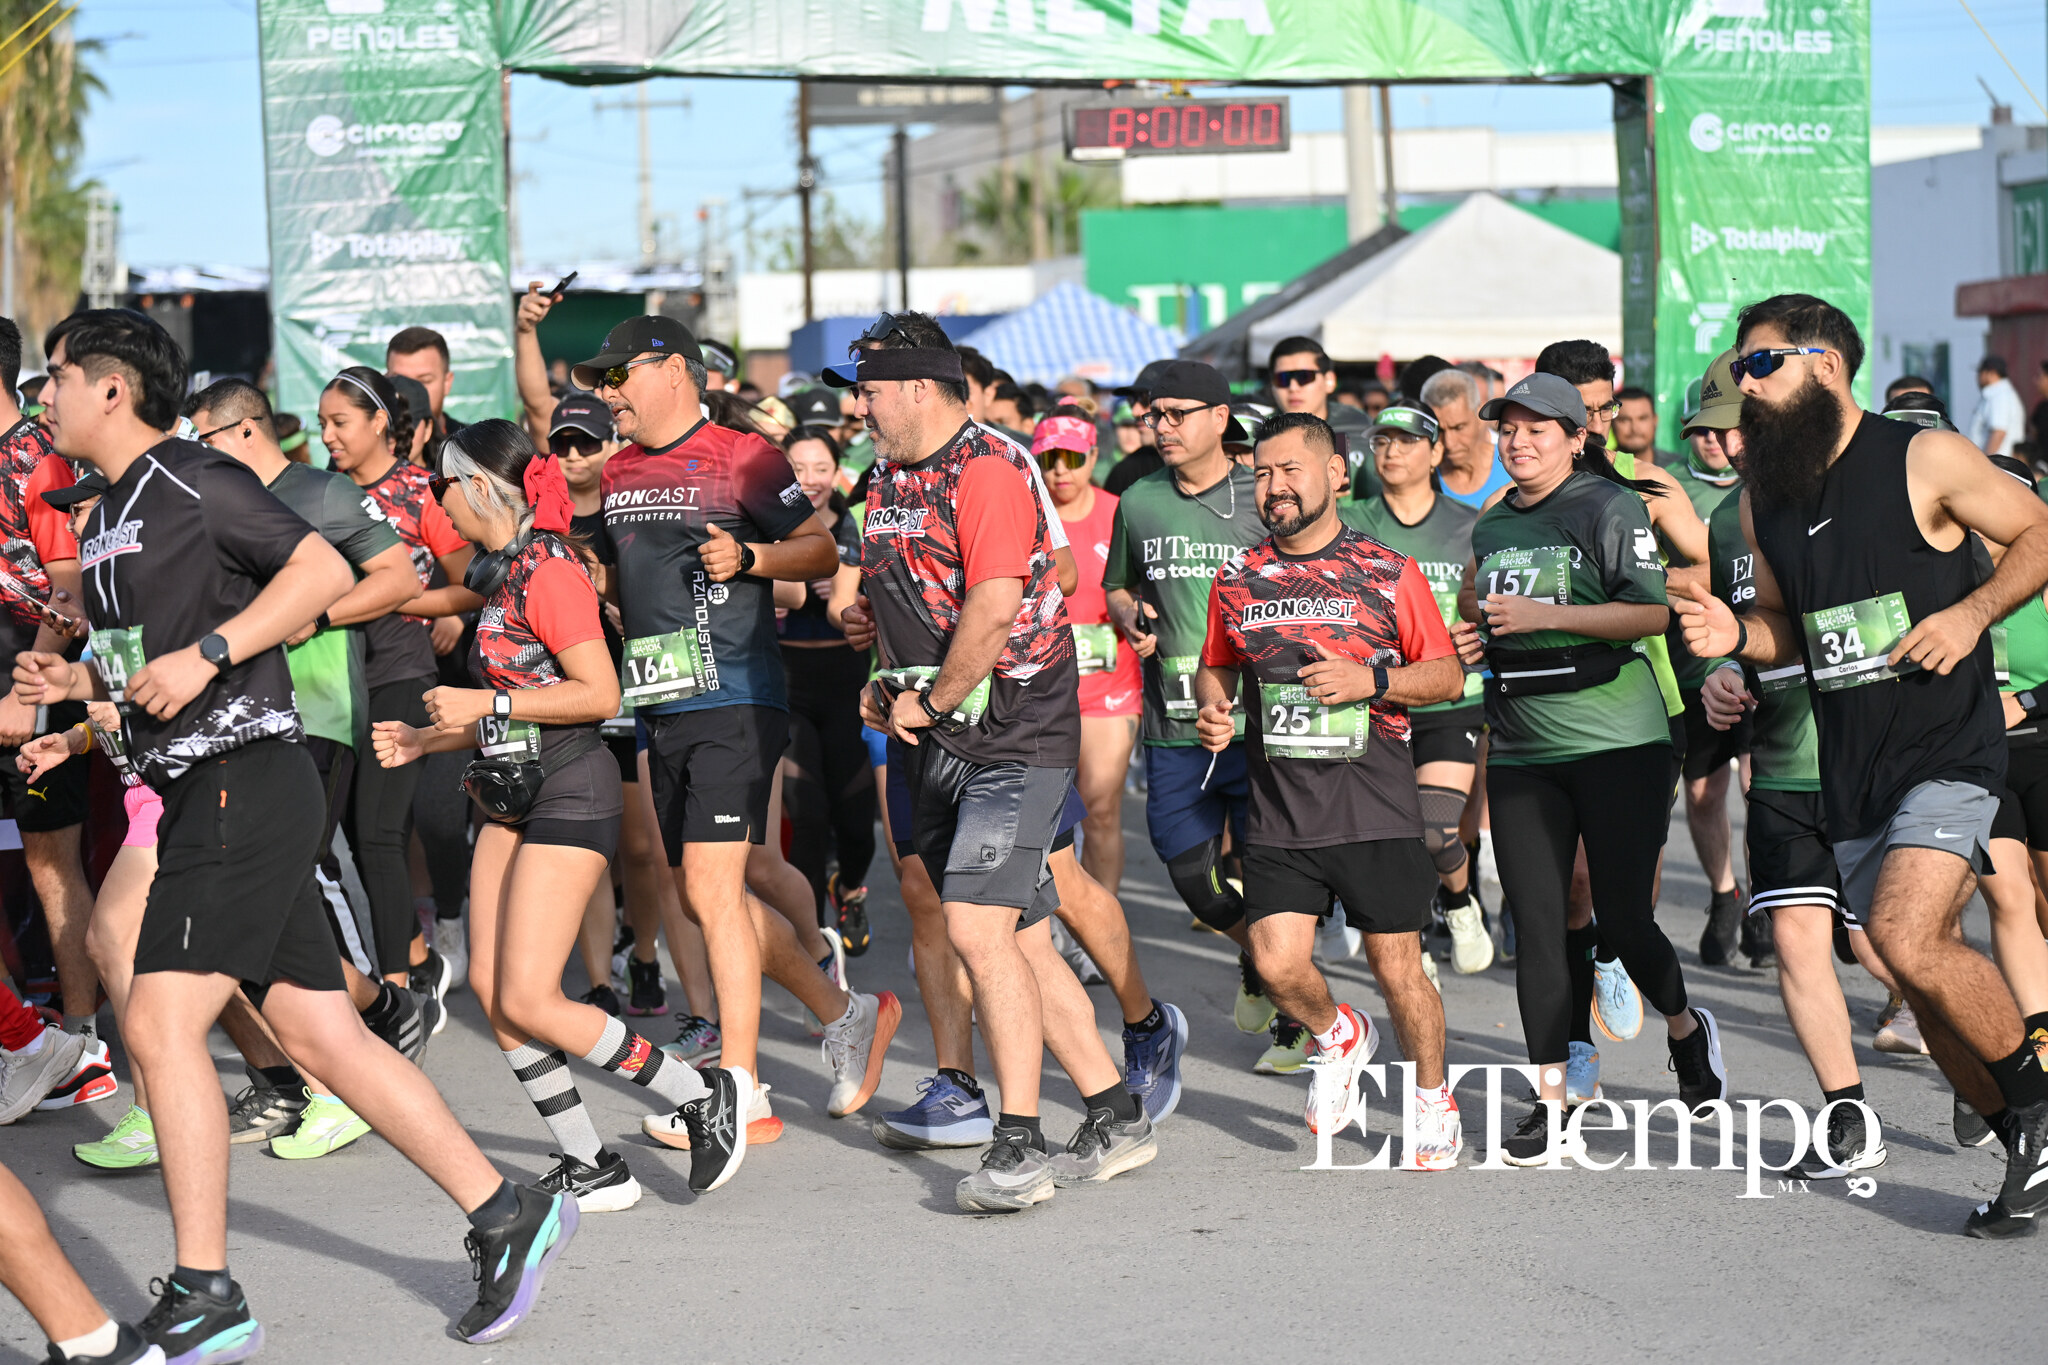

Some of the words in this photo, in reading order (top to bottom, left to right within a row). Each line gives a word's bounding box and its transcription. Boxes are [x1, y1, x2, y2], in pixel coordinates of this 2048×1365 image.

[347, 120, 465, 144] cimaco
[1726, 122, 1832, 143] cimaco
[346, 229, 464, 260] Totalplay
[1720, 226, 1827, 257] Totalplay
[604, 487, 700, 511] IRONCAST
[607, 514, 618, 526] DE
[623, 512, 682, 524] FRONTERA
[1143, 537, 1163, 563] El
[1146, 566, 1167, 581] de
[1487, 568, 1541, 597] 157
[1732, 554, 1754, 585] El
[1732, 586, 1756, 605] de
[1889, 598, 1901, 607] 34
[1243, 598, 1358, 624] IRONCAST
[1815, 606, 1855, 620] CARRERA
[693, 570, 720, 691] AZINDUSTRIES
[1821, 626, 1866, 665] 34
[628, 652, 679, 686] 164
[691, 644, 706, 687] MEDALLA
[1270, 704, 1329, 735] 251
[1354, 703, 1365, 750] MEDALLA
[527, 722, 539, 753] MEDA
[714, 814, 741, 824] Wilson
